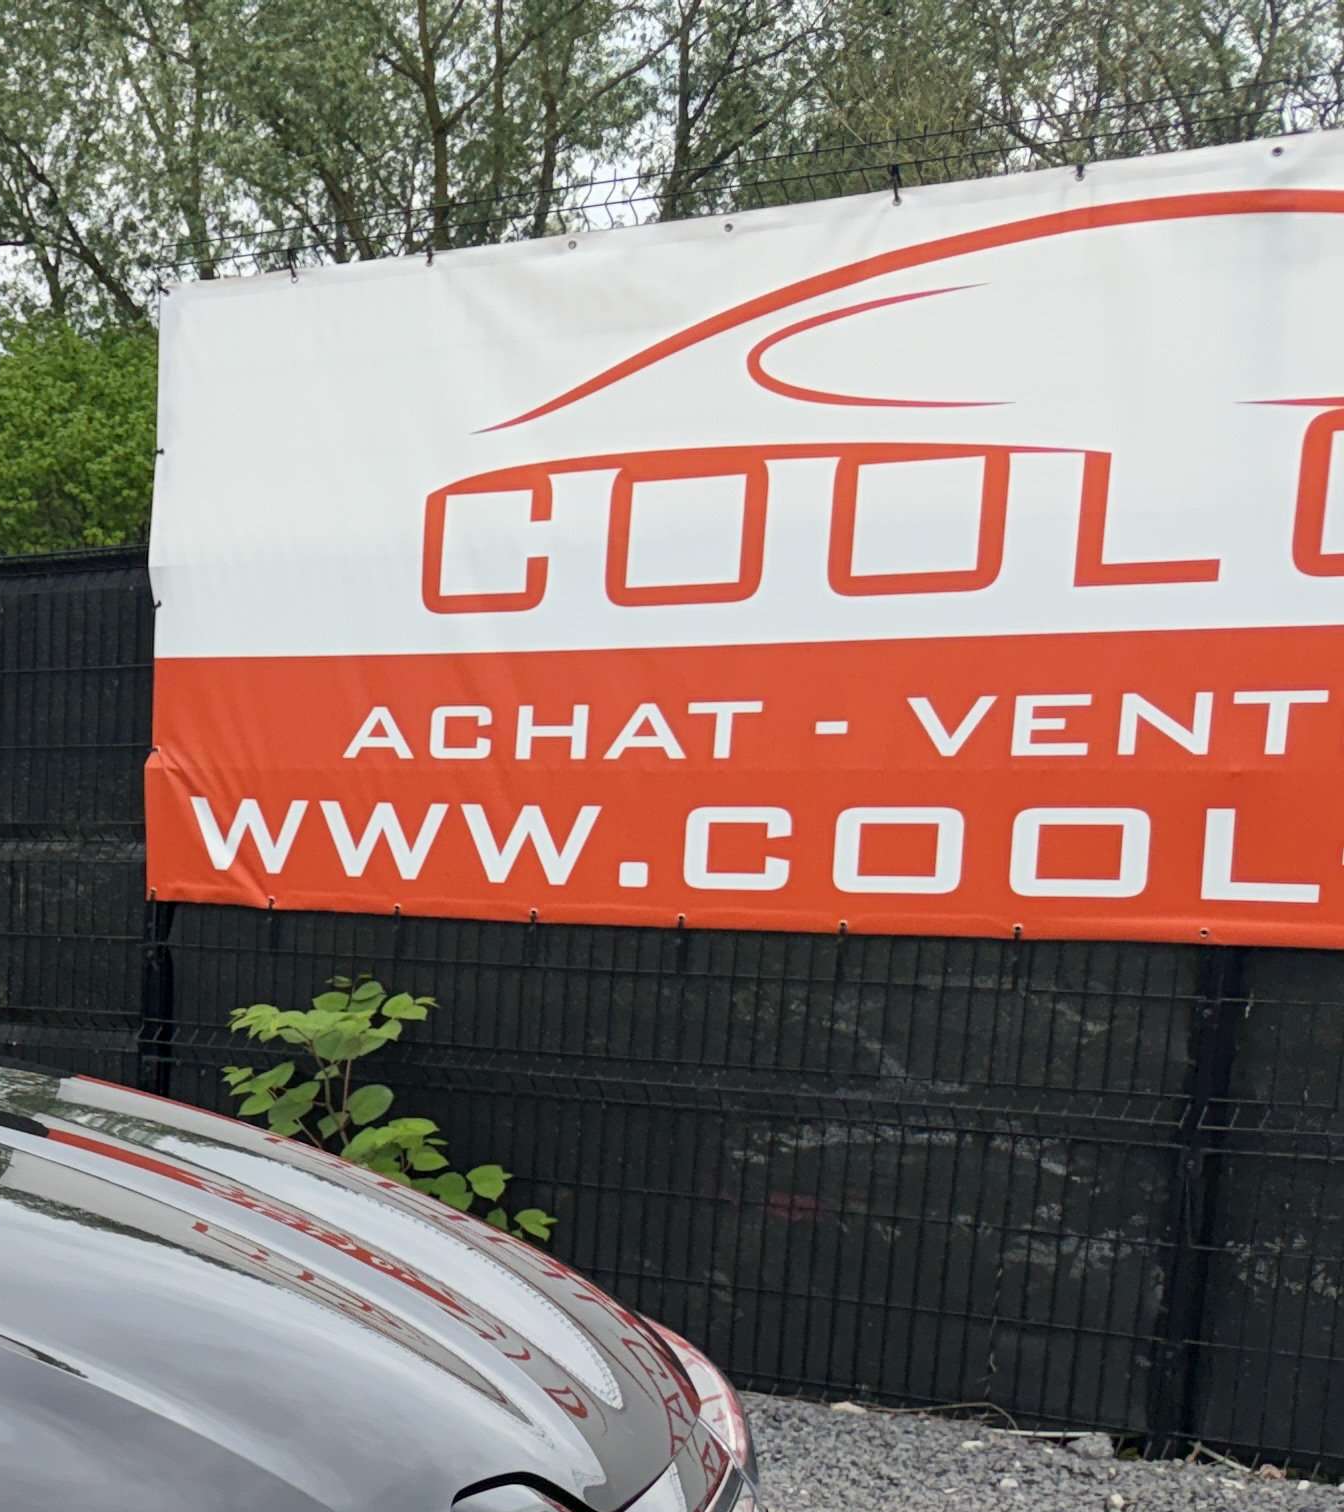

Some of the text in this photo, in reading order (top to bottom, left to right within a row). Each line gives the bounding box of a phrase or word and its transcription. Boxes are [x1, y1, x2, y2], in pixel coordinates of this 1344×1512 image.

[344, 700, 763, 760] ACHAT
[908, 689, 1329, 757] VENT
[192, 796, 1344, 904] WWW.COOL
